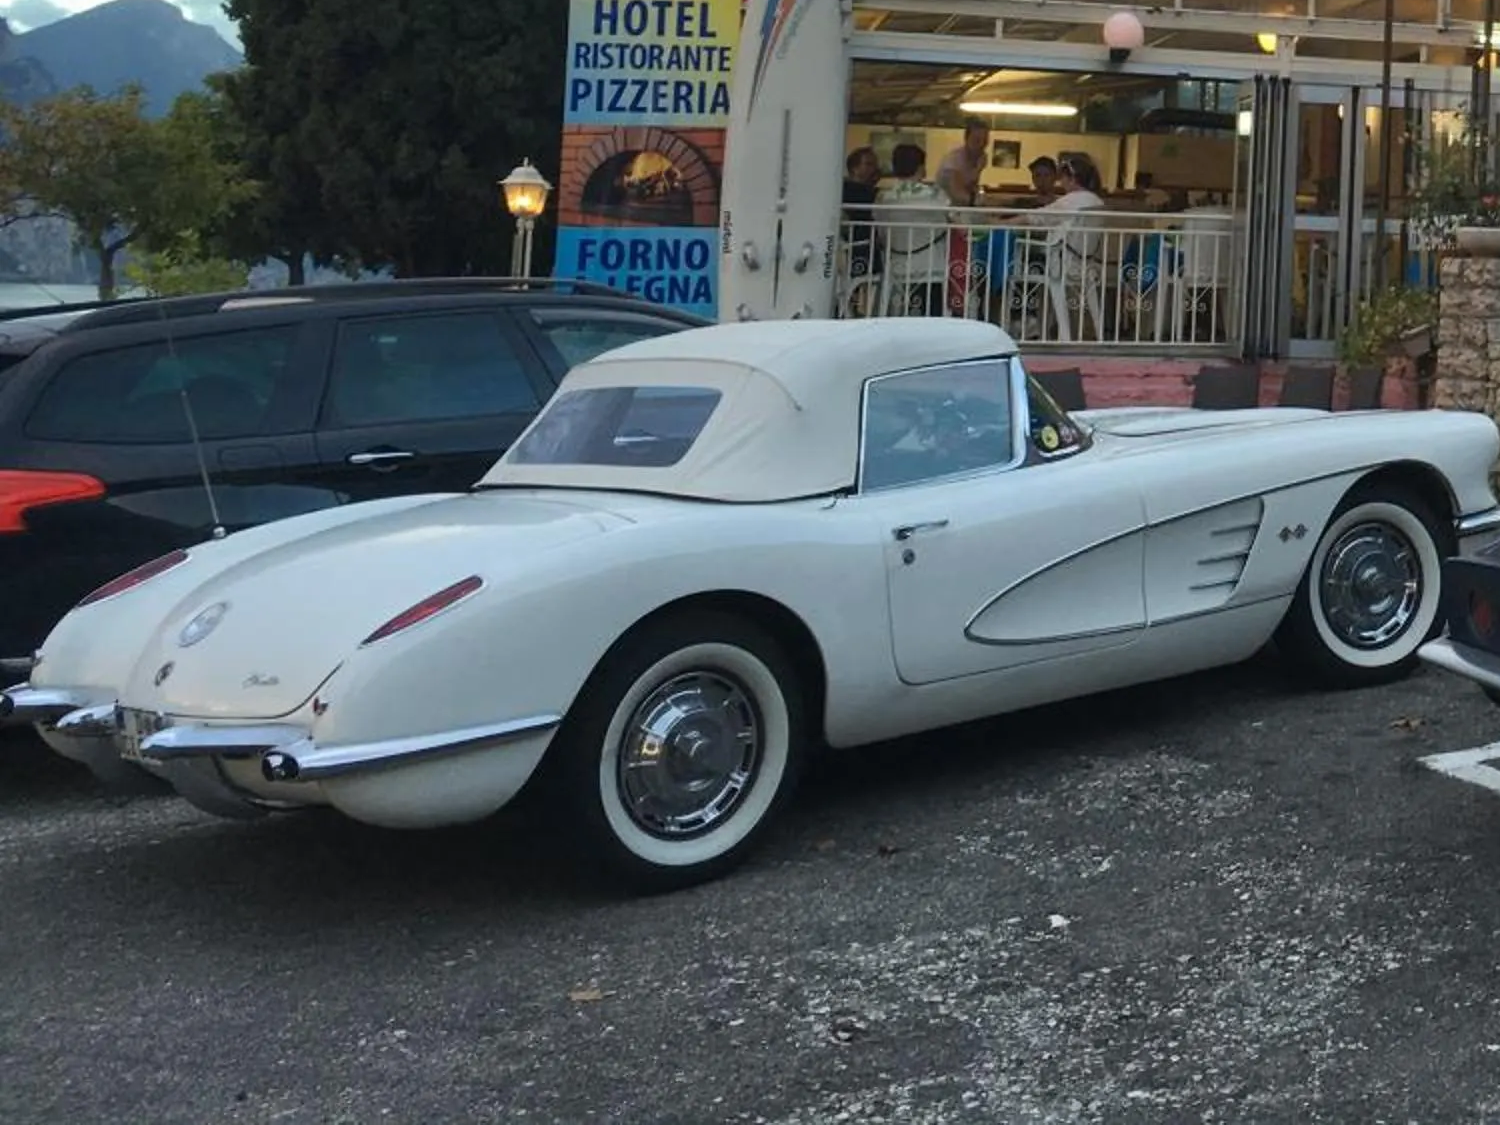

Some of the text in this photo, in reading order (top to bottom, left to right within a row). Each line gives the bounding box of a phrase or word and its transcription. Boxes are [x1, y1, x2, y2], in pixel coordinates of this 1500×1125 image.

[574, 42, 731, 72] RISTORANTE
[570, 78, 730, 115] PIZZERIA
[578, 238, 709, 271] FORNO
[608, 275, 713, 304] EGNA
